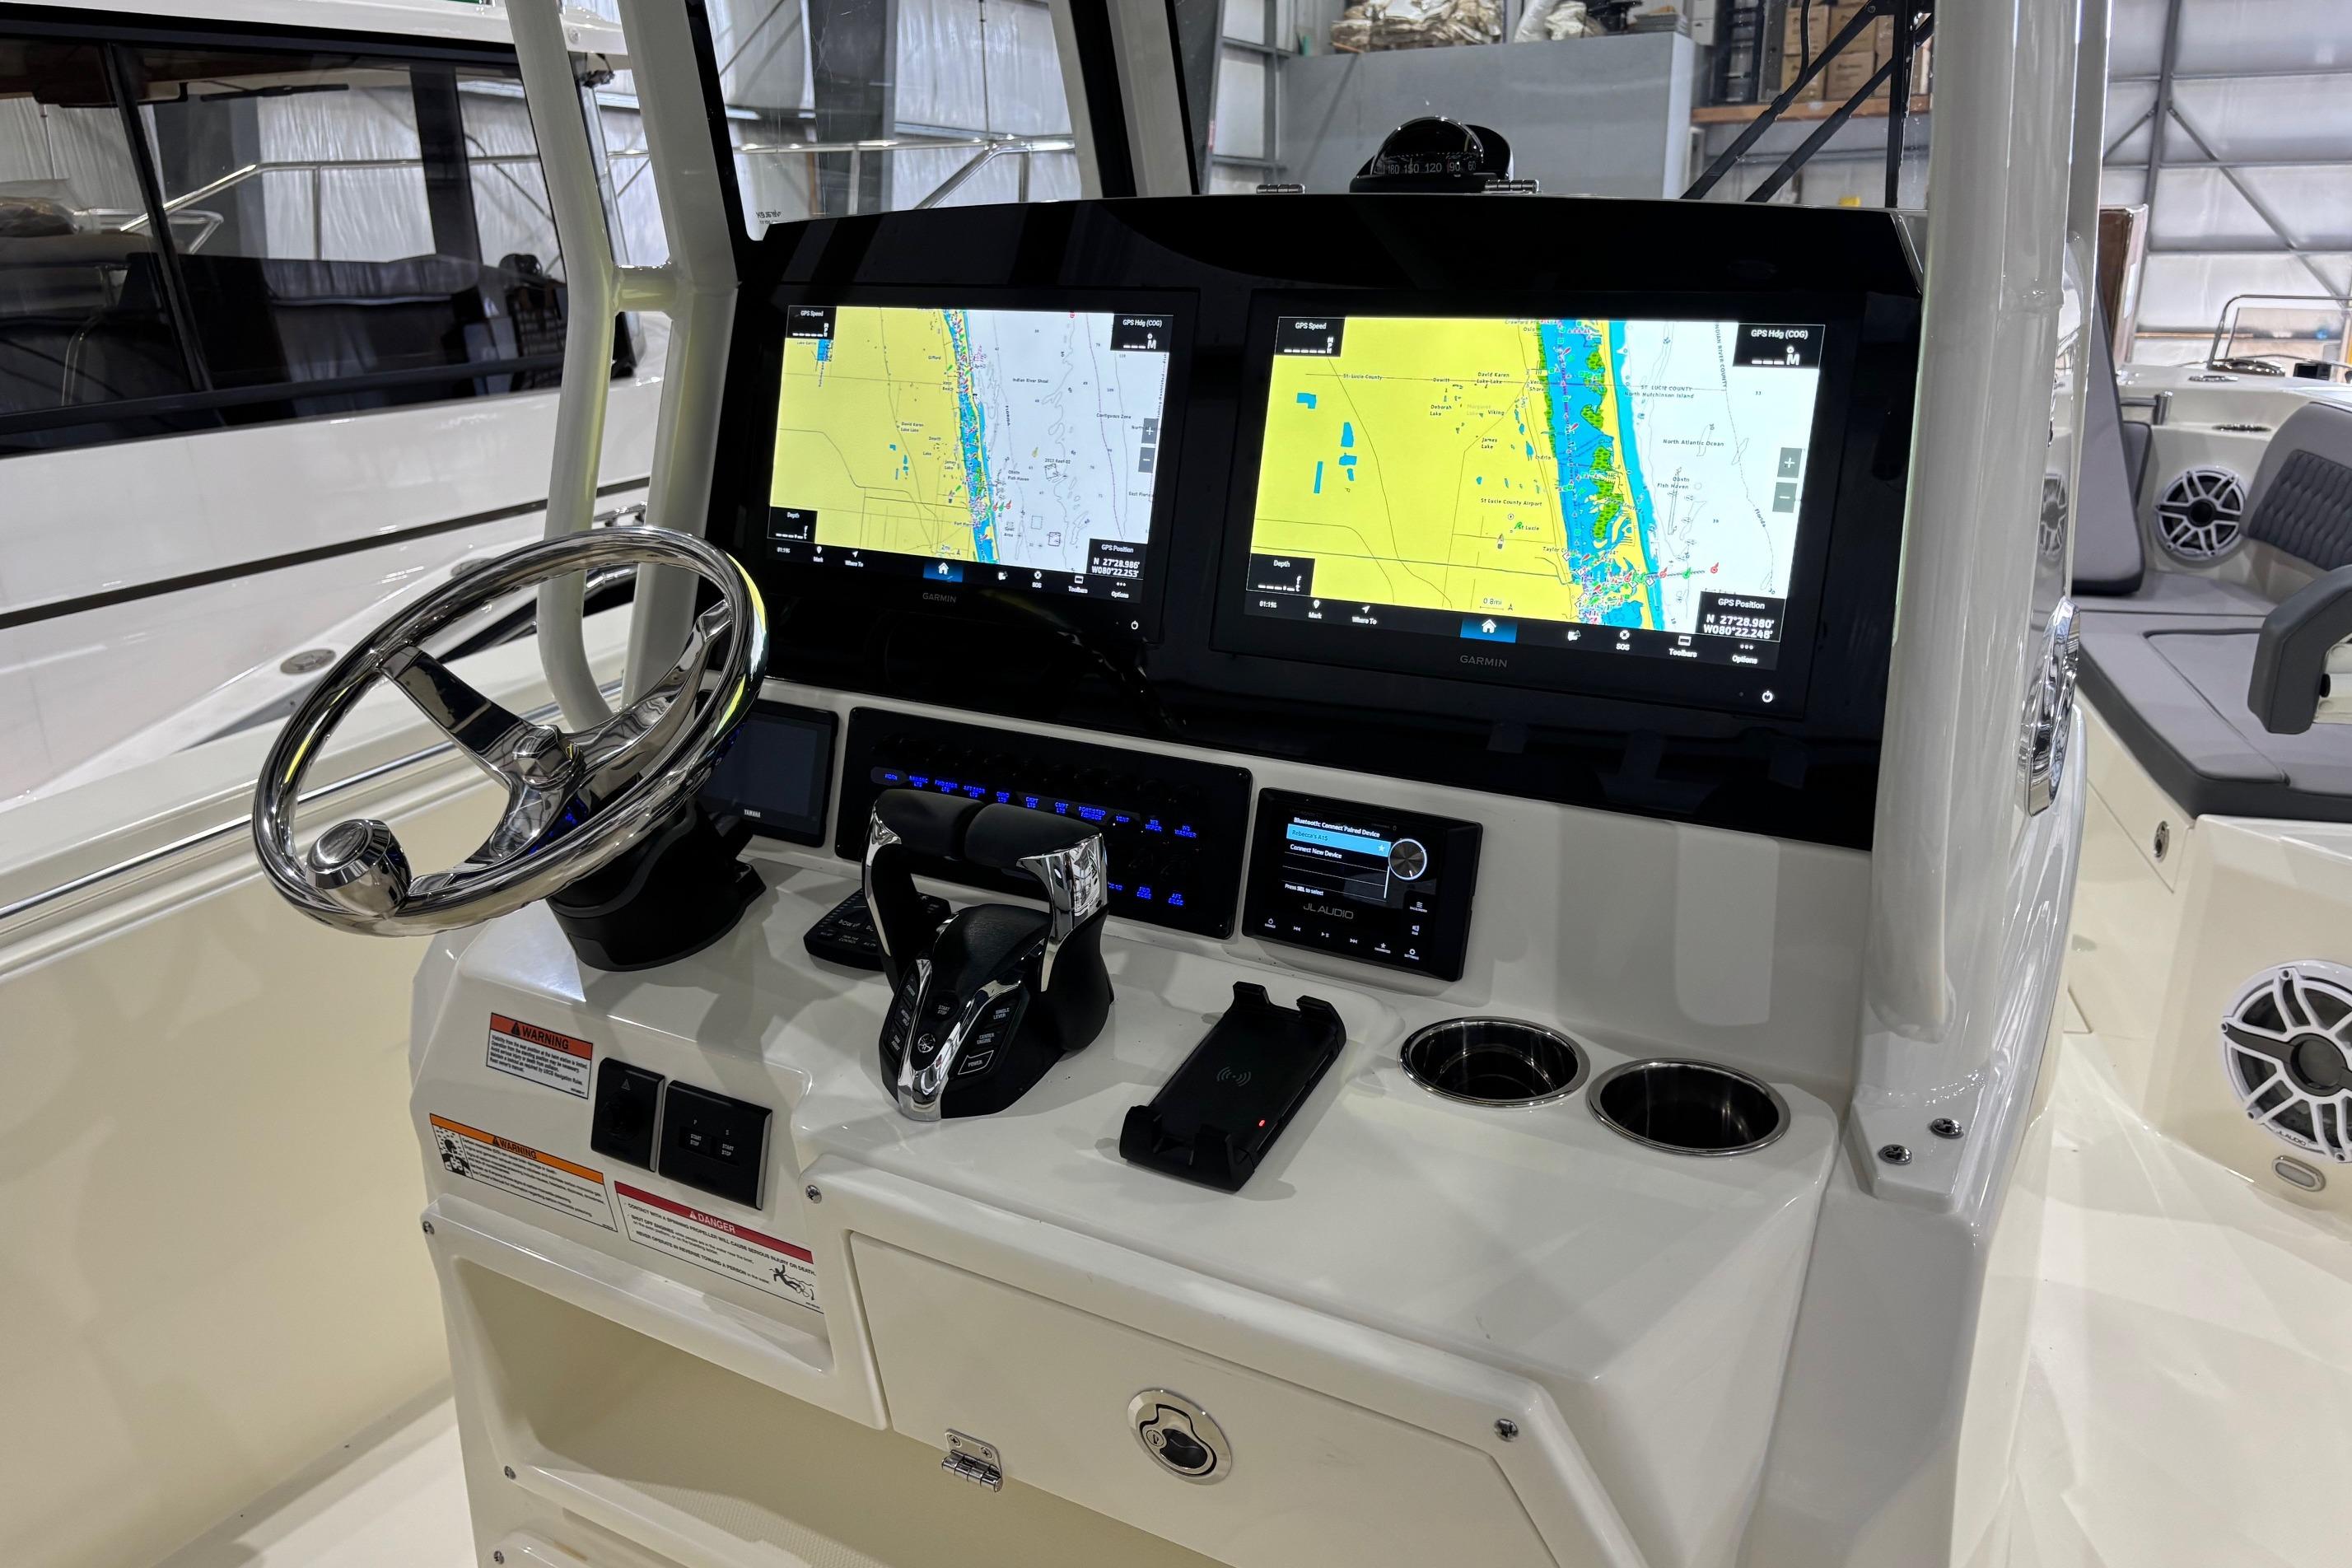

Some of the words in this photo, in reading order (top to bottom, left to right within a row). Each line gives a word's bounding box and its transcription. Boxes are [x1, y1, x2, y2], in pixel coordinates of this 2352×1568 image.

[1388, 165, 1399, 174] 180
[1404, 164, 1420, 174] 150
[1426, 162, 1442, 173] 120
[1449, 161, 1461, 171] 90
[1468, 161, 1477, 170] 60
[1146, 320, 1162, 328] (COG)
[1309, 322, 1328, 330] Speed
[1751, 329, 1767, 338] GPS
[1768, 329, 1784, 339] Hdg
[1785, 329, 1808, 339] (COG)
[1113, 545, 1134, 553] Position
[1094, 557, 1099, 566] N
[1273, 560, 1290, 568] Depth
[922, 592, 957, 603] GARMIN
[1718, 598, 1734, 607] GPS
[1735, 600, 1766, 609] Position
[1308, 611, 1323, 619] Mark
[1352, 616, 1369, 624] Where
[1706, 614, 1715, 623] N
[1616, 642, 1631, 651] SOS
[1668, 647, 1698, 658] Toolbars
[1459, 655, 1508, 668] GARMIN
[1732, 655, 1758, 665] Options
[744, 809, 761, 819] YAMAHA
[1174, 828, 1197, 838] WASHER
[1291, 829, 1318, 840] Rebecca's
[1321, 822, 1344, 831] Connect
[1344, 825, 1362, 835] Paired
[1362, 828, 1380, 838] Device
[1290, 843, 1311, 853] Connect
[1324, 850, 1343, 860] Device
[1285, 883, 1297, 891] Press
[1311, 888, 1324, 896] select
[1303, 903, 1317, 912] JL
[1318, 905, 1354, 920] AUDIO
[522, 1024, 569, 1050] WARNING
[968, 1059, 983, 1067] POWER
[2285, 1133, 2306, 1146] AUDIO
[499, 1139, 537, 1160] WARNING
[698, 1214, 736, 1234] DANGER
